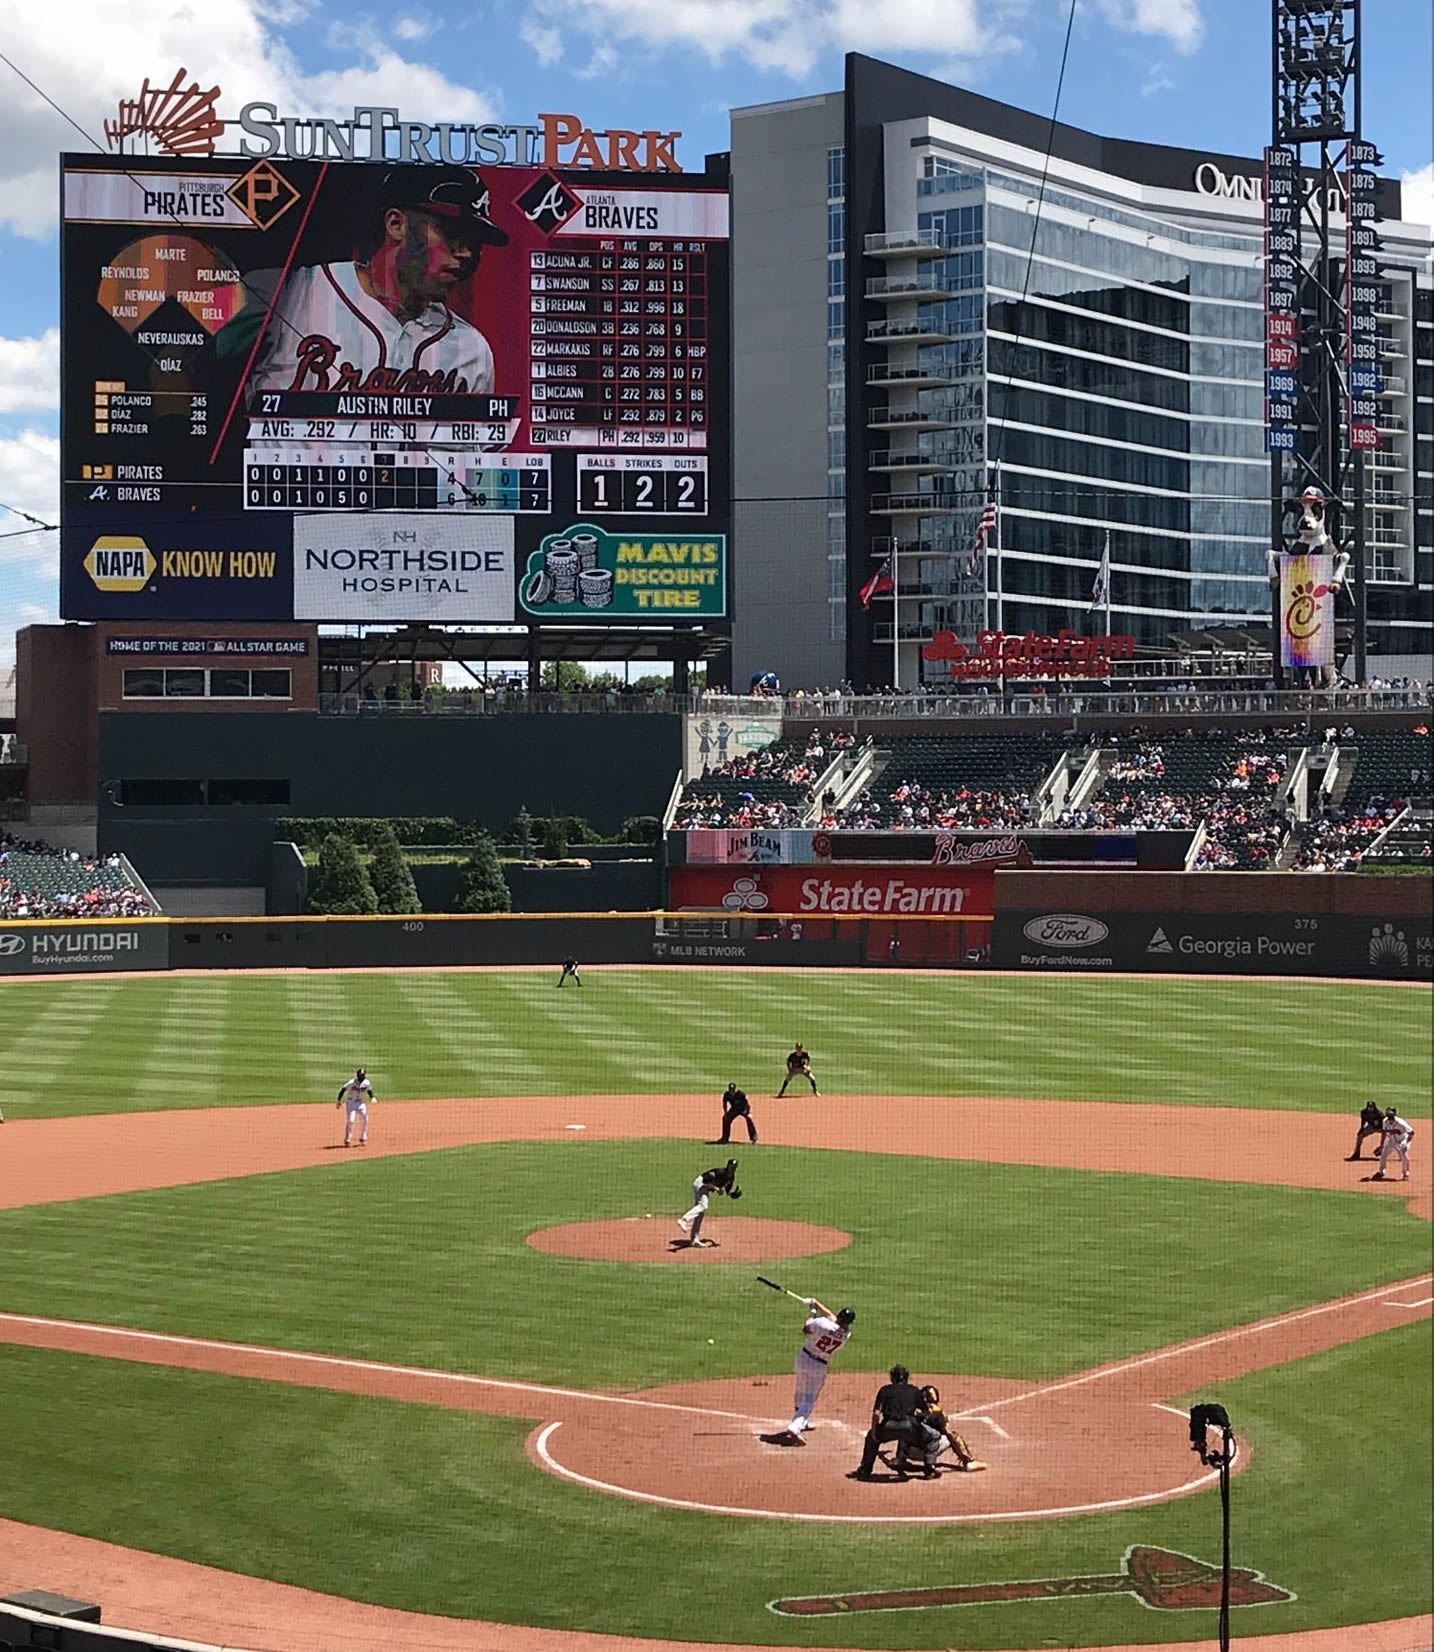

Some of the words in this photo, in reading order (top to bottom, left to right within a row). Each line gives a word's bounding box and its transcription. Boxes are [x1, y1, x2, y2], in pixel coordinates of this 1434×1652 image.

[1269, 151, 1292, 166] 1872
[1351, 145, 1375, 160] 1873
[178, 182, 225, 193] PITTSBURGH
[1269, 179, 1292, 194] 1874
[1351, 174, 1375, 189] 1875
[143, 191, 225, 217] PIRATES
[585, 195, 616, 206] ATLANTA
[1269, 207, 1291, 222] 1877
[1351, 202, 1375, 217] 1878
[585, 206, 659, 230] BRAVES
[1269, 235, 1293, 250] 1883
[1351, 231, 1375, 246] 1891
[155, 248, 187, 261] MARTE
[533, 254, 544, 267] 13
[602, 257, 613, 269] CF
[672, 259, 684, 270] 15
[1269, 263, 1293, 279] 1892
[1352, 259, 1376, 274] 1893
[101, 267, 149, 280] REYNOLDS
[197, 269, 240, 282] POLANCO
[546, 277, 590, 290] SWANSON
[601, 279, 614, 291] SS
[672, 281, 684, 292] 13
[125, 289, 166, 302] NEWMAN
[177, 290, 215, 304] FRAZIER
[1269, 291, 1292, 307] 1897
[112, 304, 138, 318] KANG
[202, 307, 224, 320] BELL
[546, 299, 586, 311] FREEMAN
[672, 303, 684, 314] 18
[546, 321, 597, 333] DONALDSON
[1269, 319, 1292, 335] 1914
[1352, 315, 1376, 331] 1948
[138, 332, 204, 346] NEVERAUSKAS
[546, 343, 590, 356] MARKAKIS
[602, 345, 614, 356] RF
[1270, 348, 1292, 363] 1957
[1352, 344, 1376, 359] 1958
[546, 364, 577, 377] ALBIES
[672, 368, 684, 379] 10
[691, 368, 703, 379] F7
[1270, 376, 1294, 391] 1969
[1352, 372, 1376, 388] 1982
[546, 386, 584, 399] MCCANN
[111, 395, 152, 406] POLANCO
[262, 395, 281, 412] 27
[337, 396, 388, 415] AUSTIN
[392, 397, 432, 415] RILEY
[489, 399, 508, 417] PH
[1352, 400, 1377, 416] 1992
[546, 408, 575, 421] JOYCE
[603, 410, 614, 421] LF
[675, 411, 682, 422] 2
[691, 411, 703, 422] P6
[1270, 404, 1293, 419] 1991
[111, 423, 149, 434] FRAZIER
[261, 422, 294, 438] AVG:
[303, 422, 335, 439] .292
[402, 423, 417, 440] 10
[487, 424, 506, 441] 29
[533, 430, 545, 443] 27
[547, 430, 572, 442] RILEY
[602, 431, 615, 442] PH
[672, 433, 684, 444] 10
[1270, 432, 1294, 447] 1993
[1352, 429, 1377, 445] 1995
[525, 457, 544, 467] LOB
[587, 458, 616, 468] BALLS
[625, 459, 663, 468] STRIKES
[674, 459, 698, 468] OUTS
[117, 465, 163, 480] PIRATES
[251, 467, 259, 481] 0
[272, 468, 281, 481] 0
[295, 468, 303, 482] 1
[317, 468, 324, 482] 1
[337, 469, 346, 482] 0
[359, 469, 367, 482] 0
[380, 469, 389, 482] 2
[447, 471, 456, 485] 4
[475, 472, 483, 486] 7
[501, 472, 509, 485] 0
[531, 472, 539, 485] 7
[117, 487, 161, 501] BRAVES
[594, 475, 608, 507] 1
[636, 475, 653, 507] 2
[678, 475, 695, 508] 2
[306, 549, 505, 572] NORTHSIDE
[616, 542, 718, 564] MAVIS
[96, 550, 145, 578] NAPA
[162, 551, 223, 578] KNOW
[230, 551, 276, 579] HOW
[615, 568, 718, 586] DISCOUNT
[342, 577, 469, 593] HOSPITAL
[632, 589, 702, 608] TIRE
[109, 641, 141, 652] HOME
[142, 641, 157, 652] OF
[158, 641, 179, 652] THE
[182, 641, 206, 652] 2021
[227, 641, 245, 652] ALL
[247, 641, 274, 652] STAR
[275, 641, 305, 652] GAME
[430, 668, 441, 683] R
[727, 836, 748, 858] JIM
[750, 831, 782, 856] BEAM
[402, 921, 424, 933] 400
[1041, 919, 1091, 941] Ford
[1294, 918, 1319, 930] 375
[32, 932, 139, 953] HYUNDAI
[1178, 934, 1252, 959] Georgia
[1257, 937, 1316, 956] Power
[670, 945, 693, 957] MLB
[694, 946, 746, 958] NETWORK
[32, 954, 114, 966] BuyHyundai.com
[1020, 954, 1113, 967] BuyFordNow.com
[815, 1335, 843, 1354] 27
